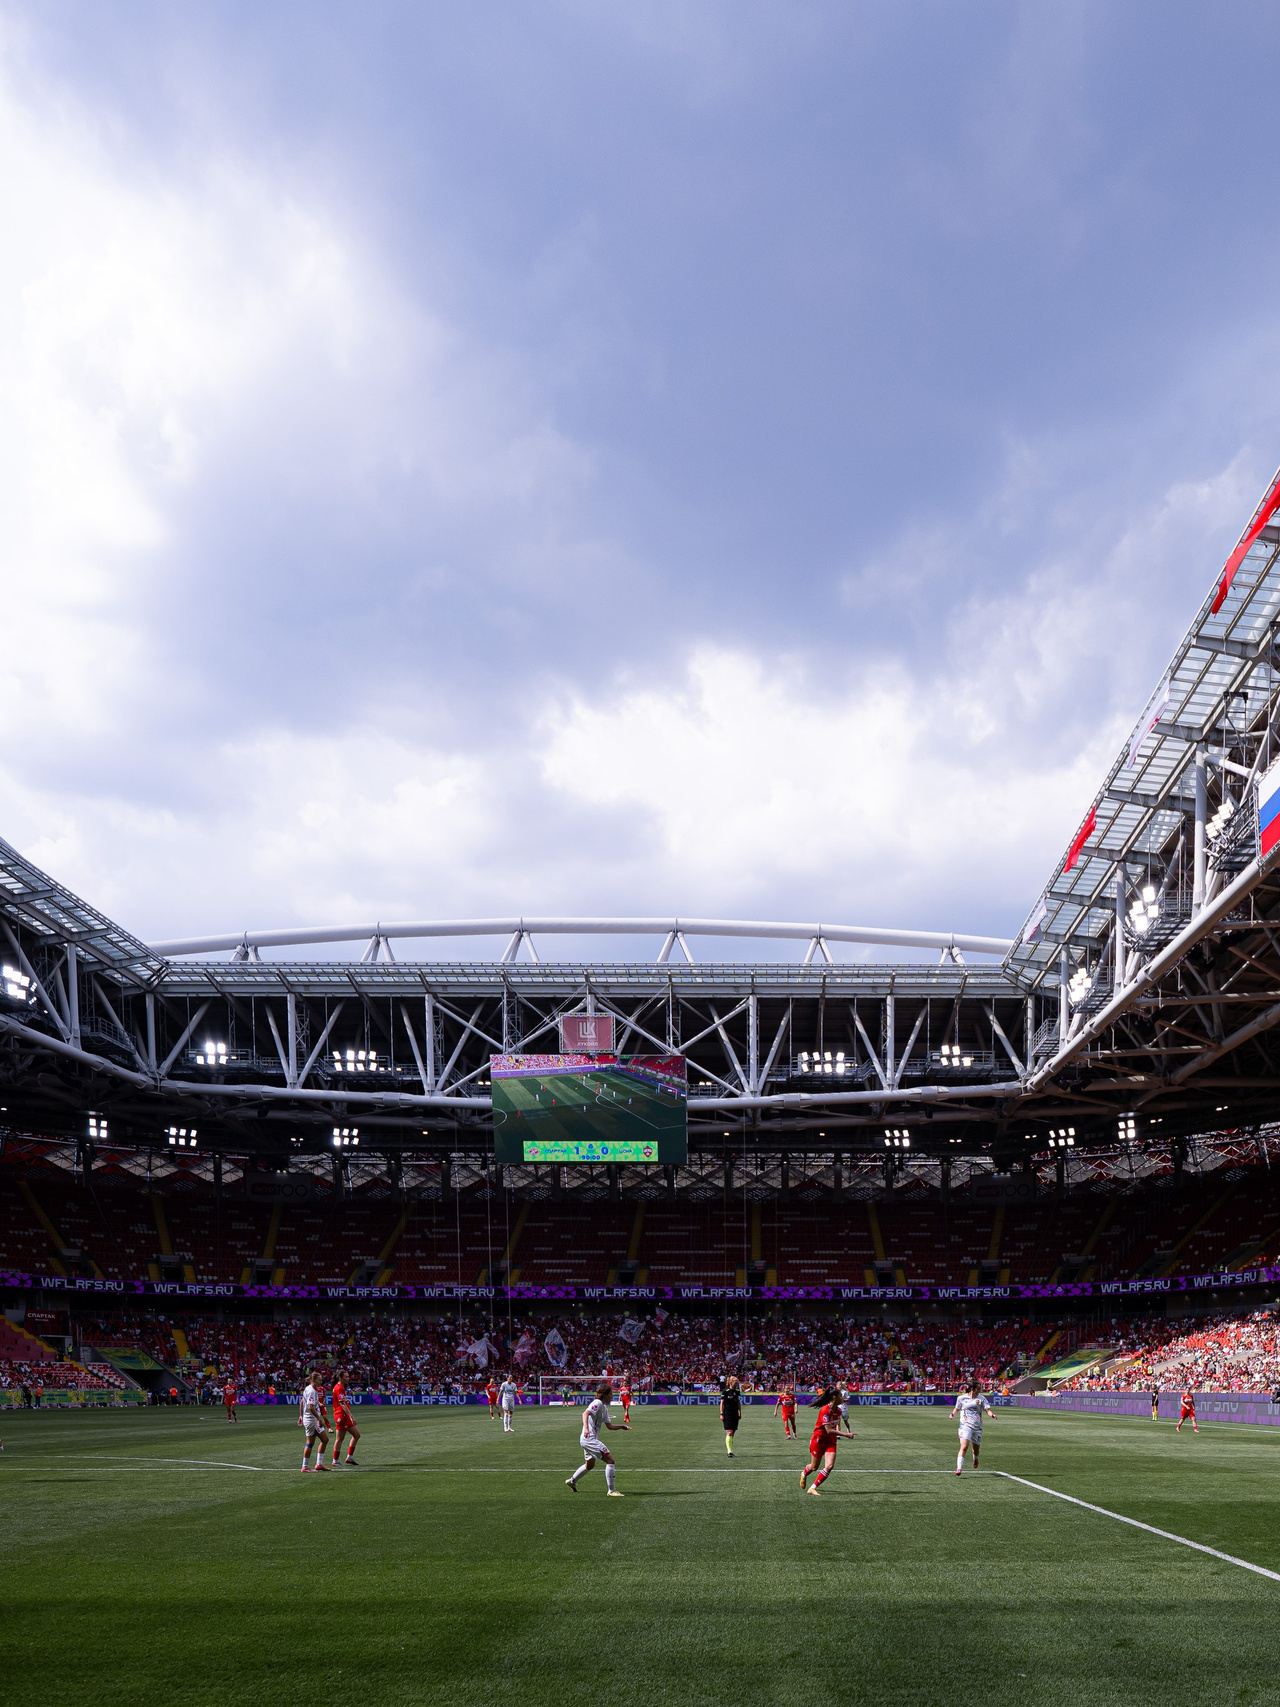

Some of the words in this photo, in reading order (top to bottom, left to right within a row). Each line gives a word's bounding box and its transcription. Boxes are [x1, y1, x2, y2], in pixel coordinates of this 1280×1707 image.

[574, 1146, 580, 1155] 1
[601, 1146, 609, 1155] 0
[41, 1277, 124, 1291] WFL.RFS.RU
[1193, 1272, 1257, 1288] WFL.RFS.RU
[154, 1283, 233, 1295] WFL.RFS.RU
[1101, 1280, 1170, 1293] WFL.RFS.RU
[327, 1288, 398, 1297] WFL.RFS.RU
[424, 1288, 495, 1297] WFL.RFS.RU
[584, 1288, 655, 1297] WFL.RFS.RU
[681, 1288, 752, 1298] WFL.RFS.RU
[841, 1288, 912, 1298] WFL.RFS.RU
[938, 1287, 1010, 1298] WFL.RFS.RU
[390, 1395, 467, 1405] WFL.RFS.RU
[858, 1396, 935, 1406] WFL.RFS.RU
